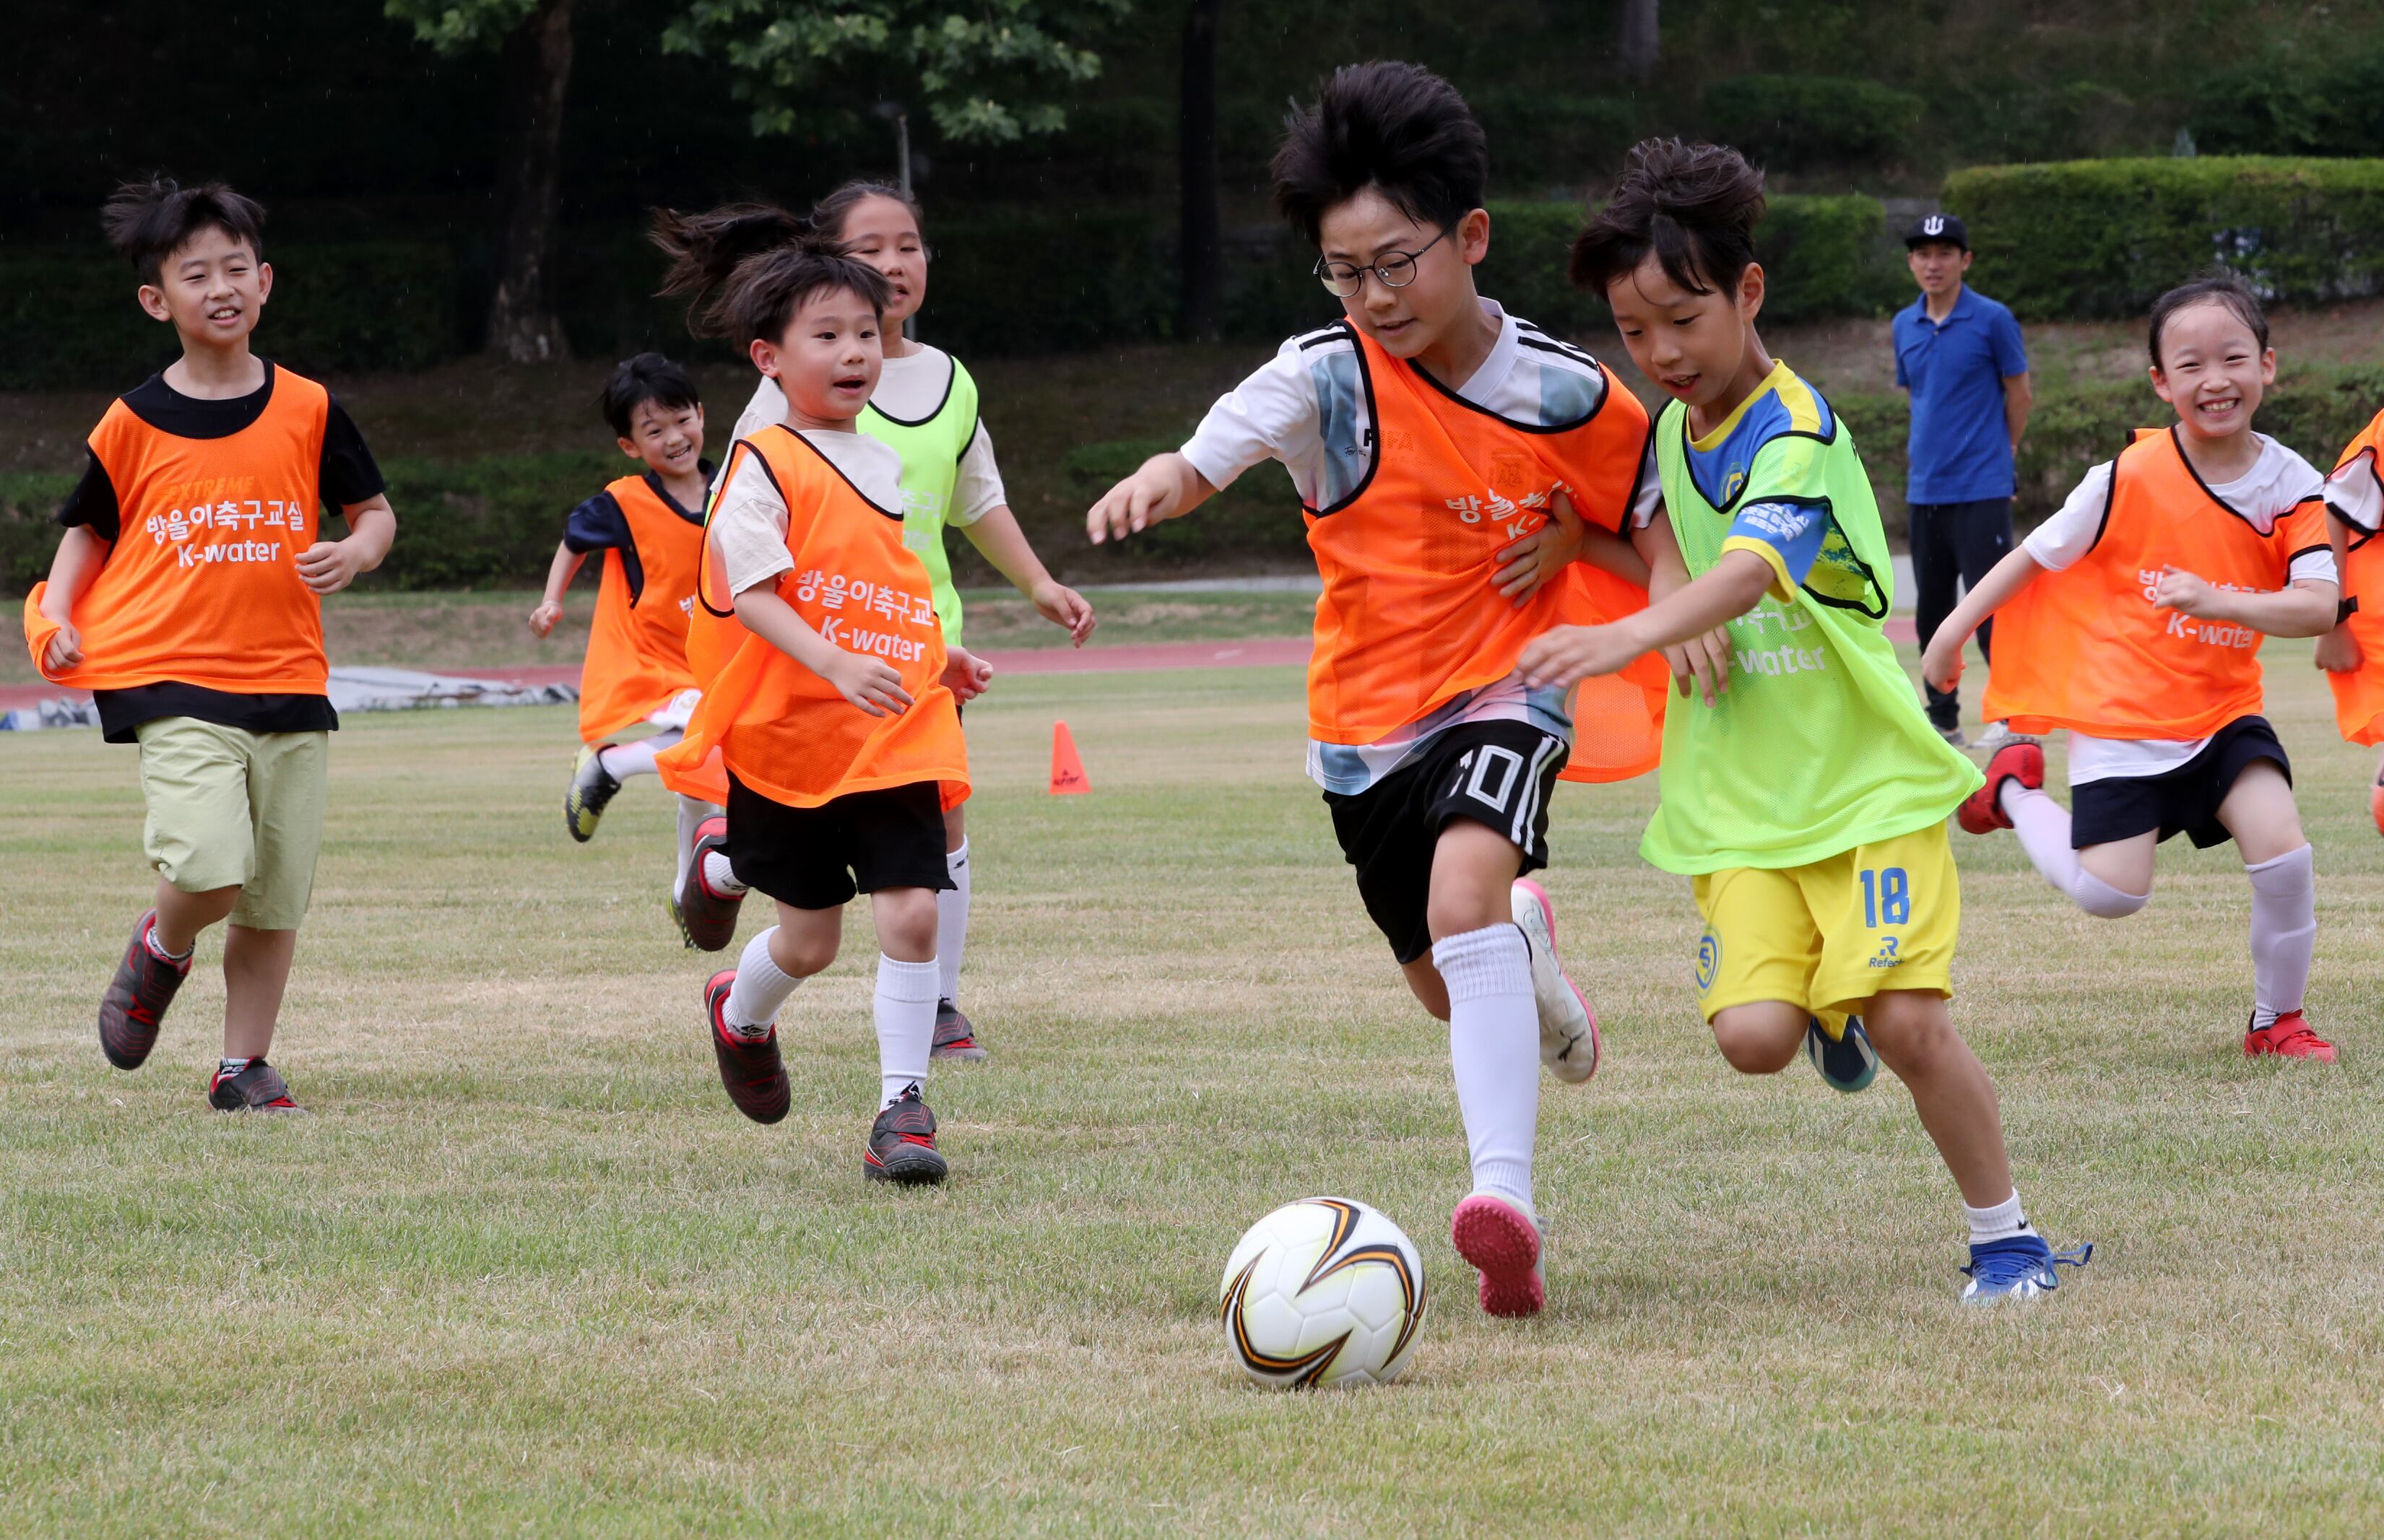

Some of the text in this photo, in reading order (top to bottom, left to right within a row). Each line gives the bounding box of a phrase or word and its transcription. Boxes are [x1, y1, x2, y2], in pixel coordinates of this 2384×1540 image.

[147, 500, 304, 545] 방울이축구교실
[177, 539, 281, 567] K-water
[820, 615, 925, 662] K-water
[1728, 644, 1825, 676] -water
[1860, 867, 1910, 928] 18
